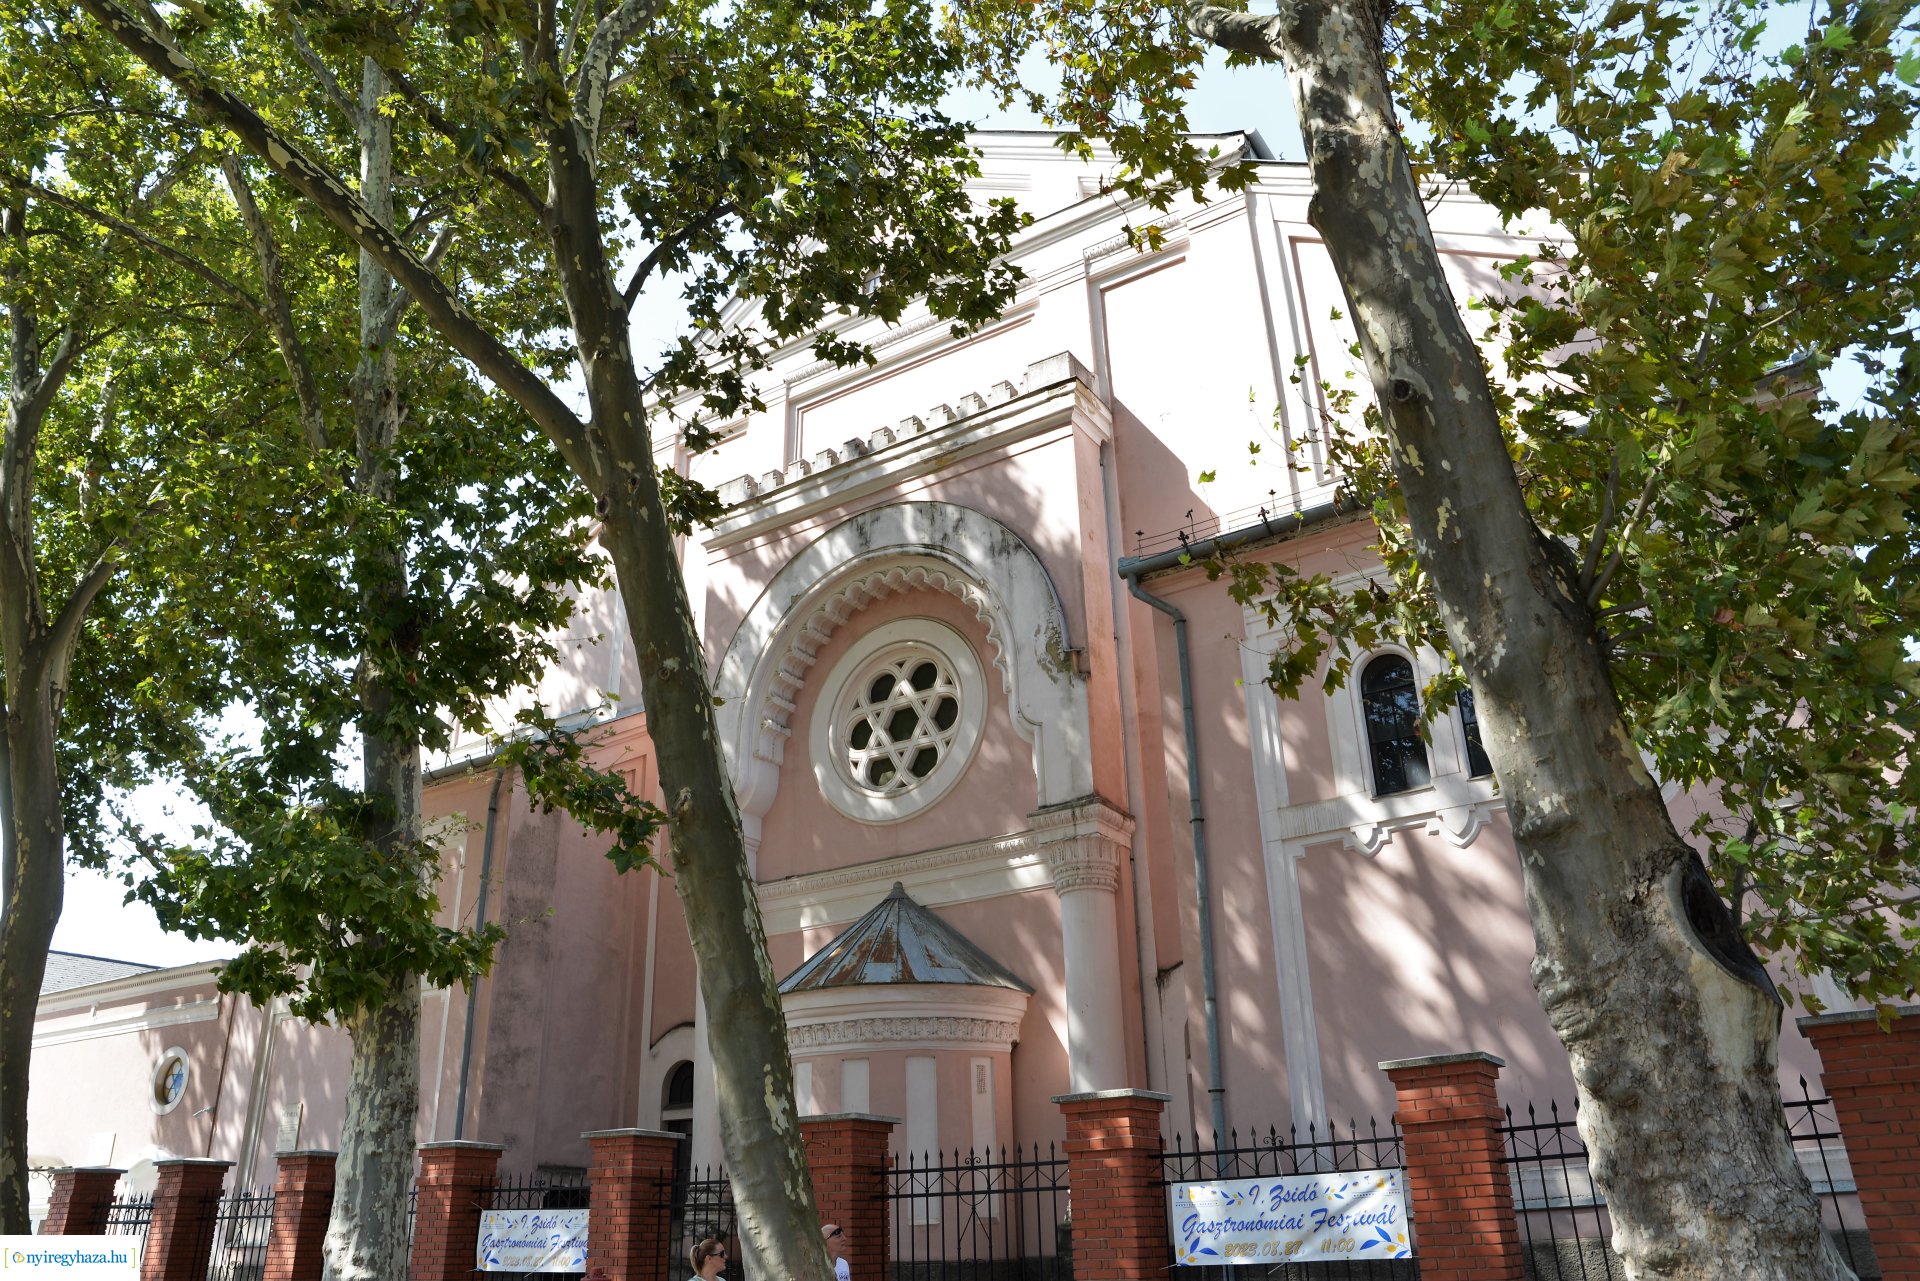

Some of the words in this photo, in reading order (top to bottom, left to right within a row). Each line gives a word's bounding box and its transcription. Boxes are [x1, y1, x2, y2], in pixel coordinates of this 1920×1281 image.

[1269, 1182, 1318, 1212] Zsidó
[531, 1215, 558, 1235] Zsidó
[1182, 1212, 1304, 1241] Gasztronómiai
[1310, 1204, 1397, 1234] Fesztivál
[482, 1233, 547, 1253] Gasztronómiai
[1320, 1237, 1356, 1254] 11:00
